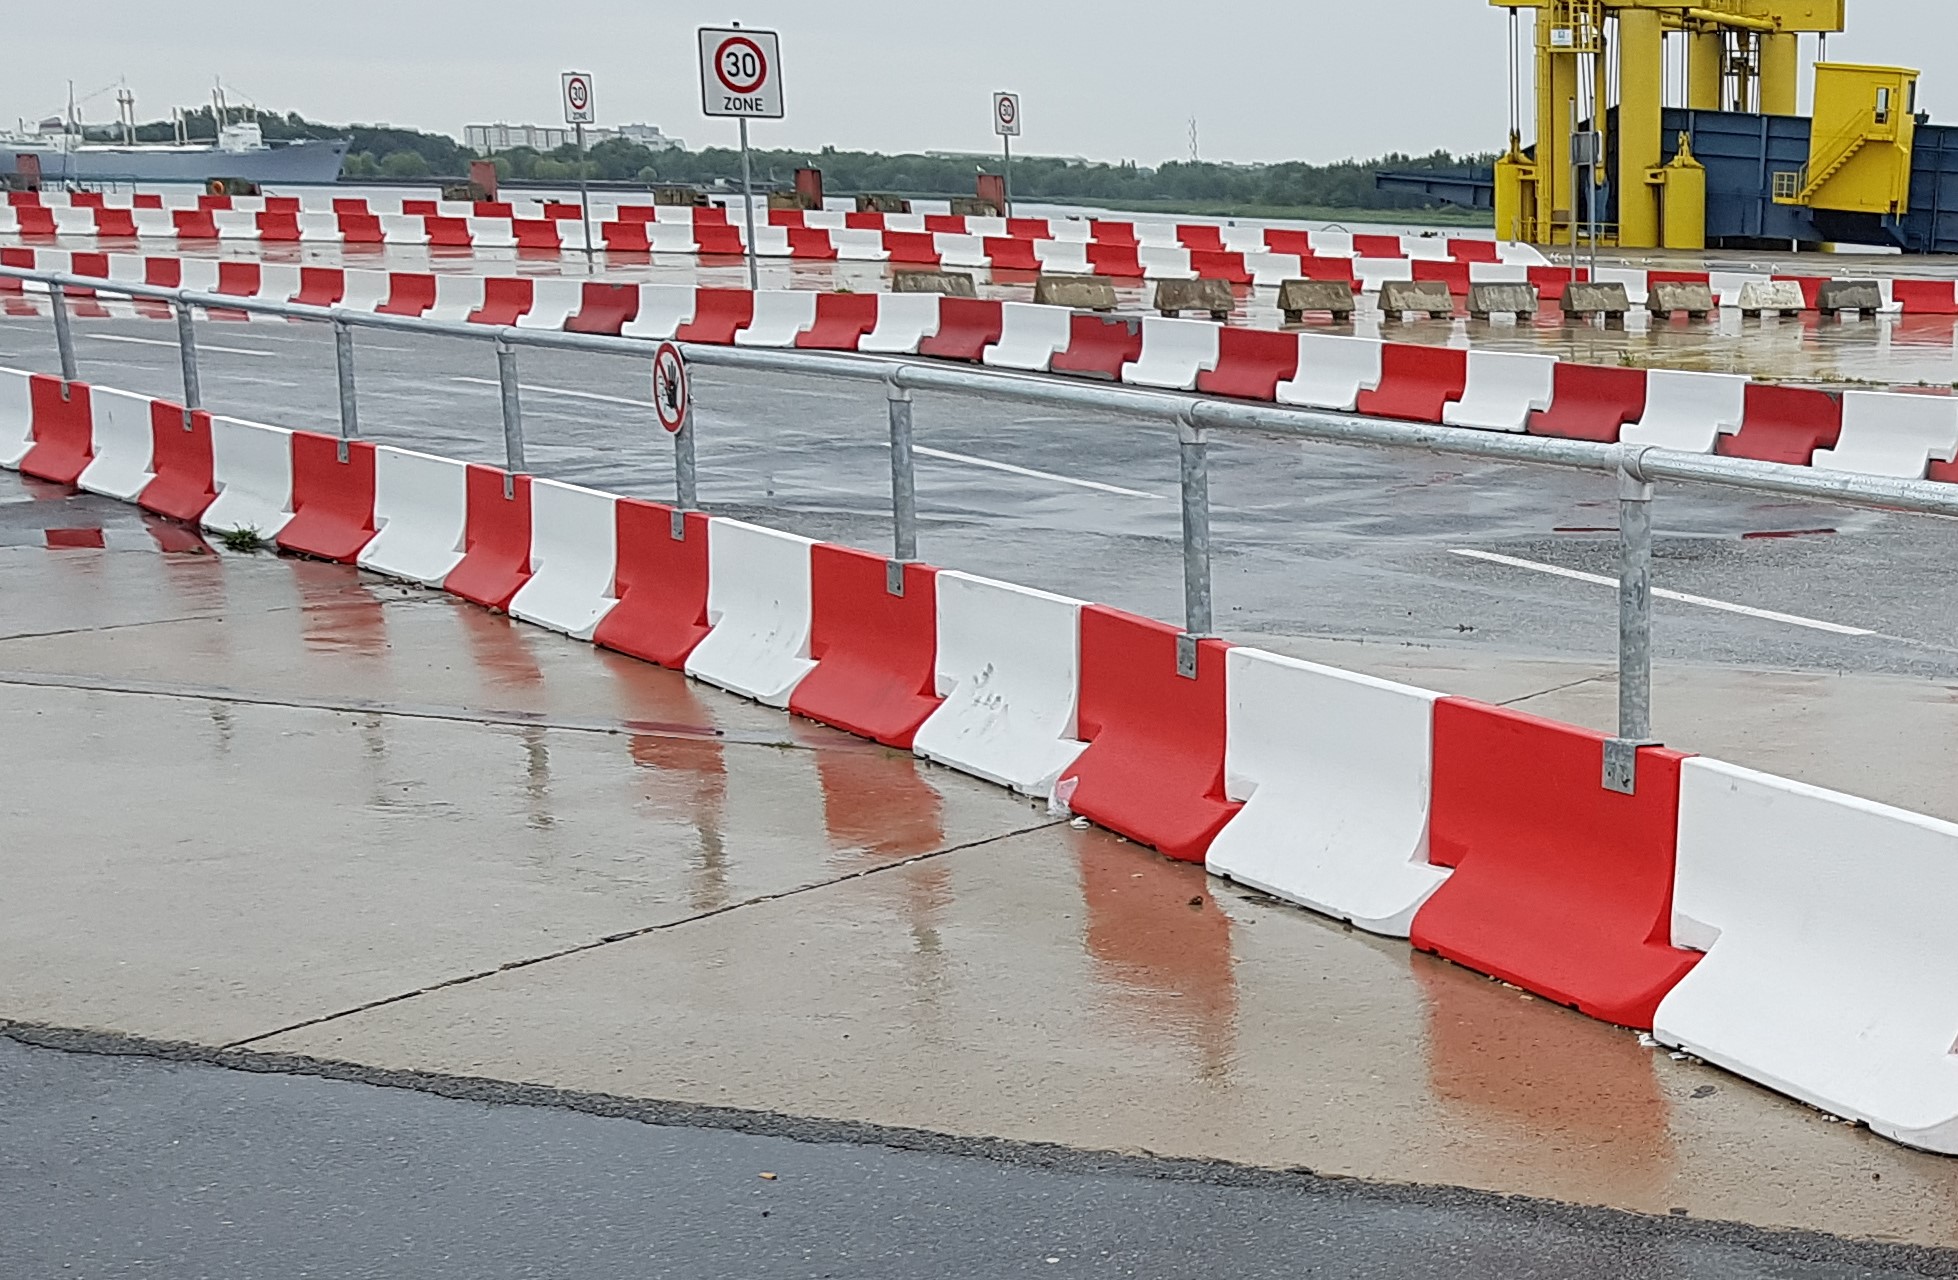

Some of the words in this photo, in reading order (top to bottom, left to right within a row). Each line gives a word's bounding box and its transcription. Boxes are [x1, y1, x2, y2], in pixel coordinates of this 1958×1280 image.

[726, 51, 756, 78] 30
[572, 86, 584, 101] 30
[723, 96, 764, 112] ZONE
